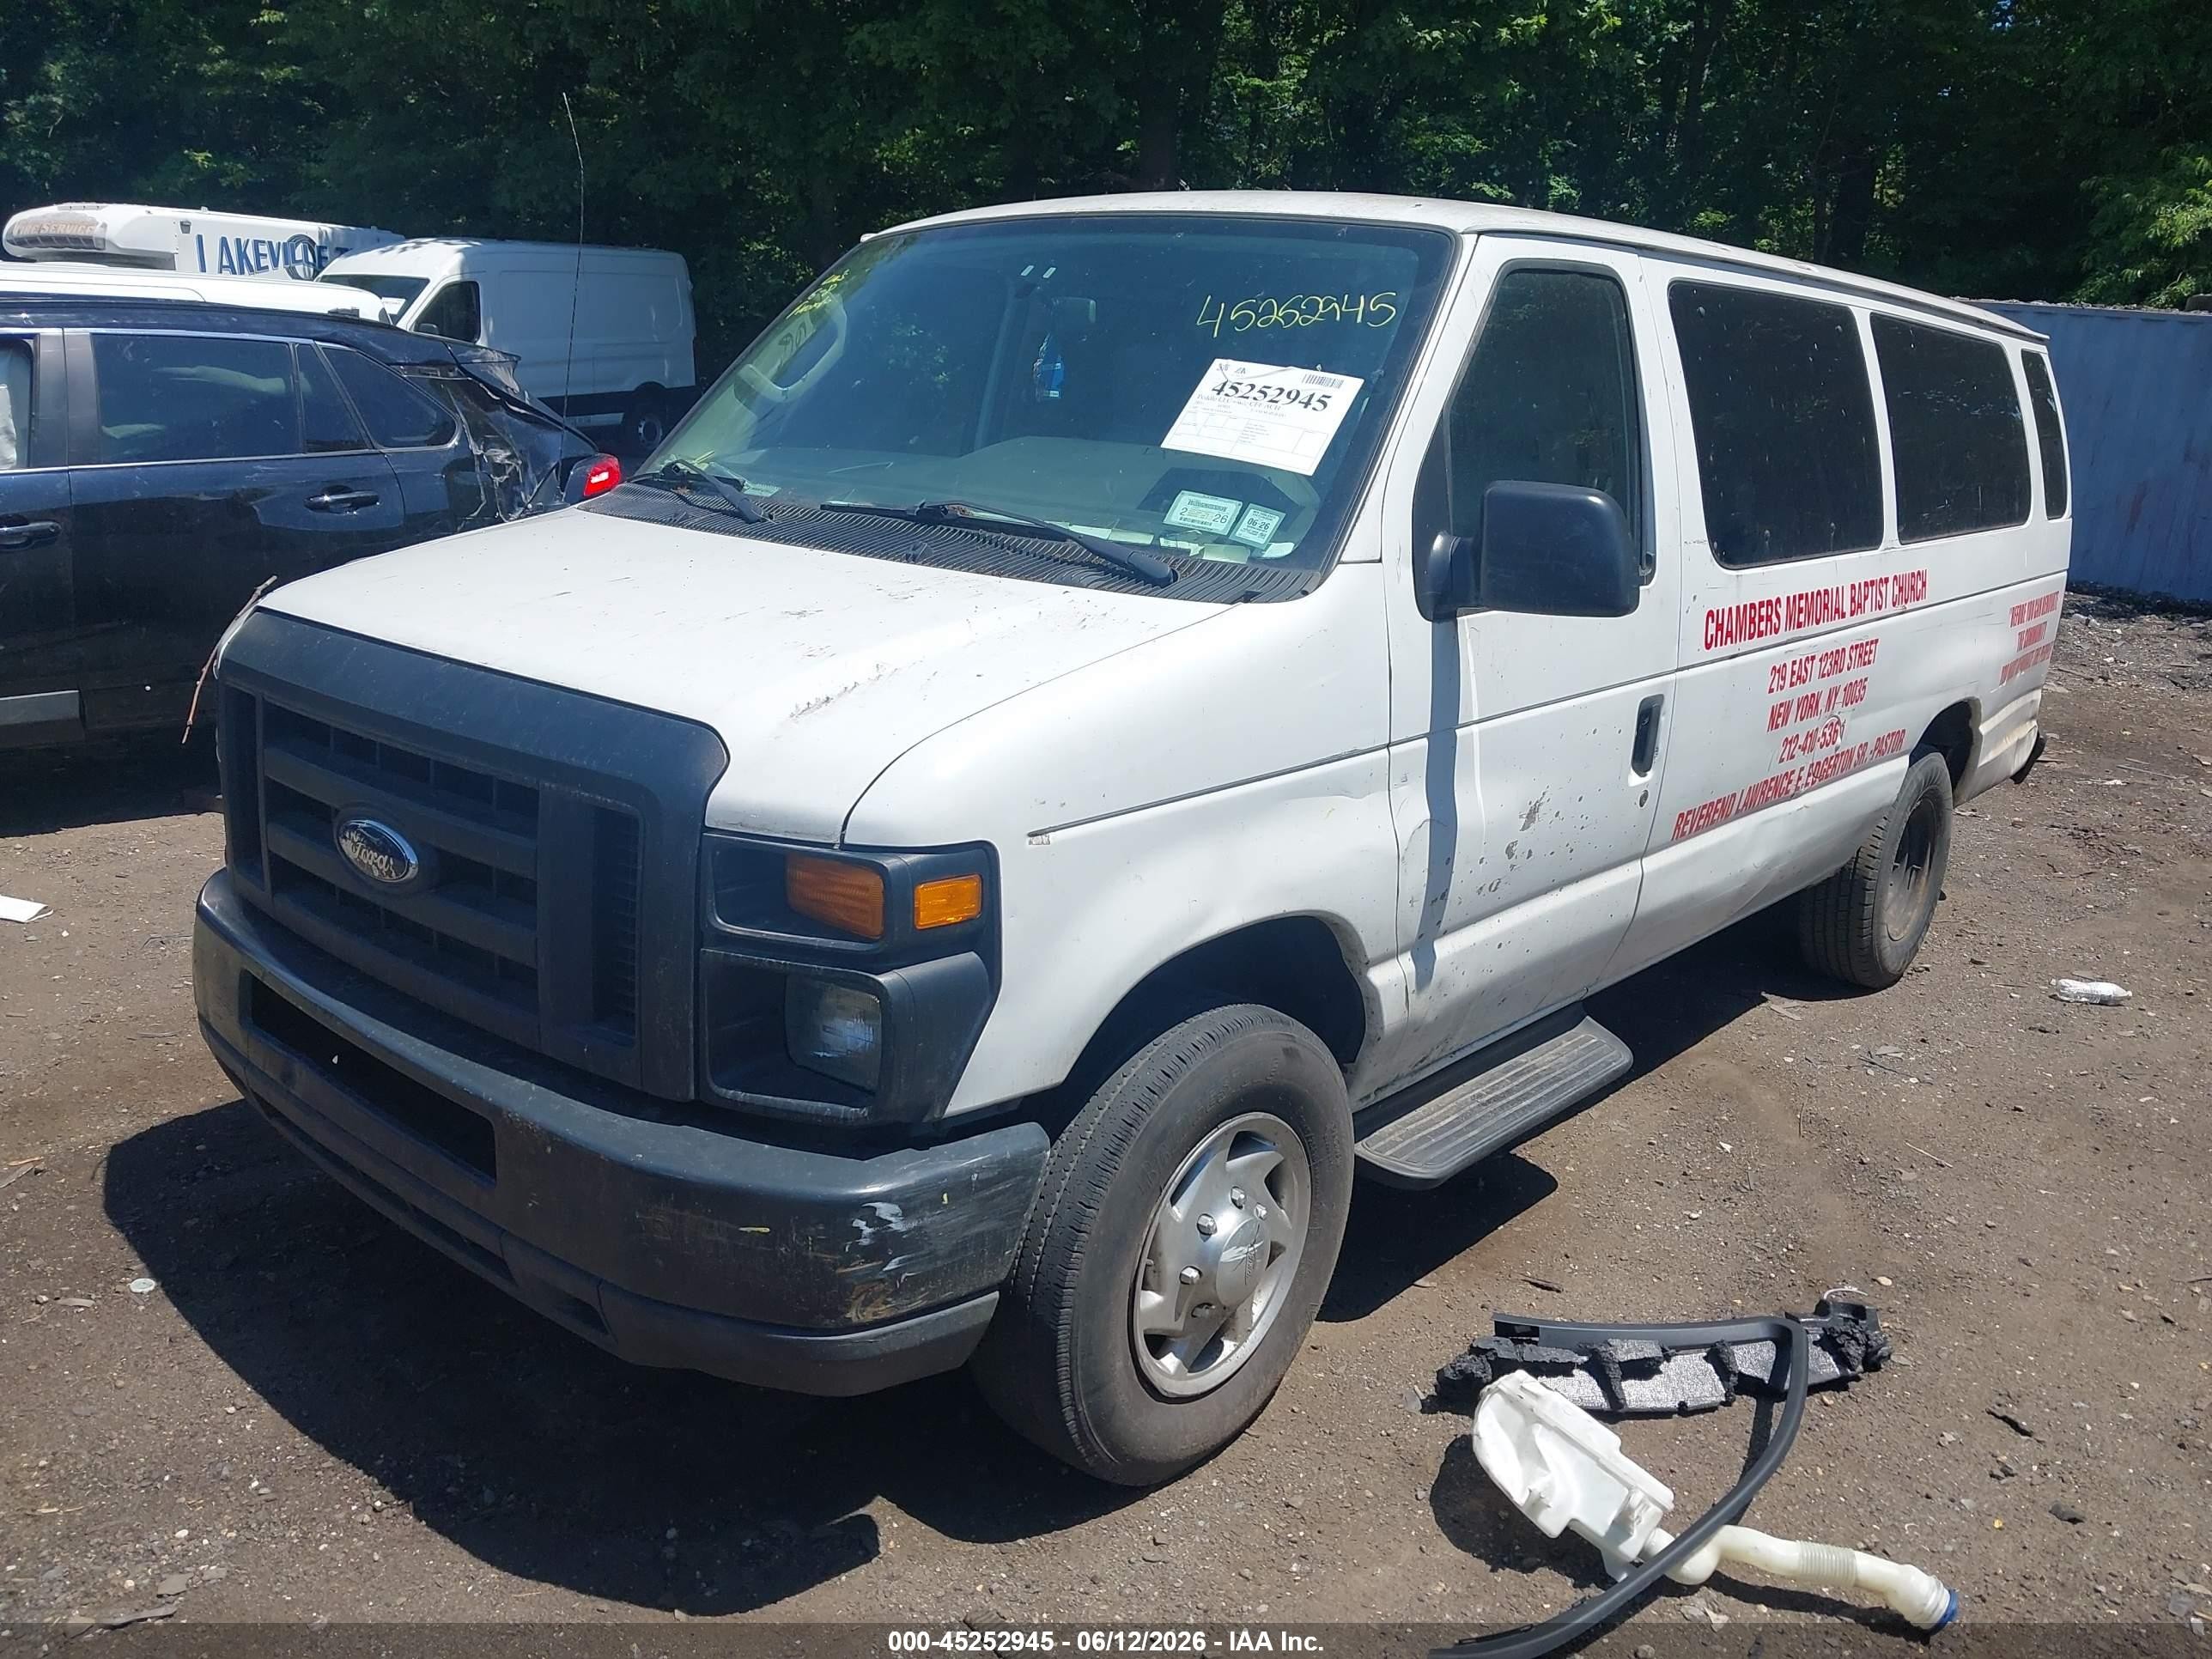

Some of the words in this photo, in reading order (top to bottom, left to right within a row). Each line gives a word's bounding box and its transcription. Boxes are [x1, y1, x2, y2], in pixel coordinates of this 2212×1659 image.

[1212, 380, 1332, 411] 45252945
[1212, 514, 1229, 524] 26
[1705, 596, 1782, 650] CHAMBERS
[1785, 586, 1847, 632] MEMORIAL
[1849, 576, 1890, 617] BAPTIST
[1892, 569, 1928, 607] CHURCH
[1768, 662, 1787, 694] 219
[1790, 655, 1816, 688] EAST
[1818, 647, 1846, 679] 123RD
[1847, 639, 1879, 672] STREET
[1767, 698, 1794, 732] NEW
[1794, 690, 1823, 720] YORK,
[1825, 684, 1841, 712] NY
[1841, 677, 1869, 708] 10035
[1671, 792, 1737, 841] REVEREND
[1735, 769, 1796, 816] LAWRENCE
[1804, 746, 1856, 788] EDGERTON
